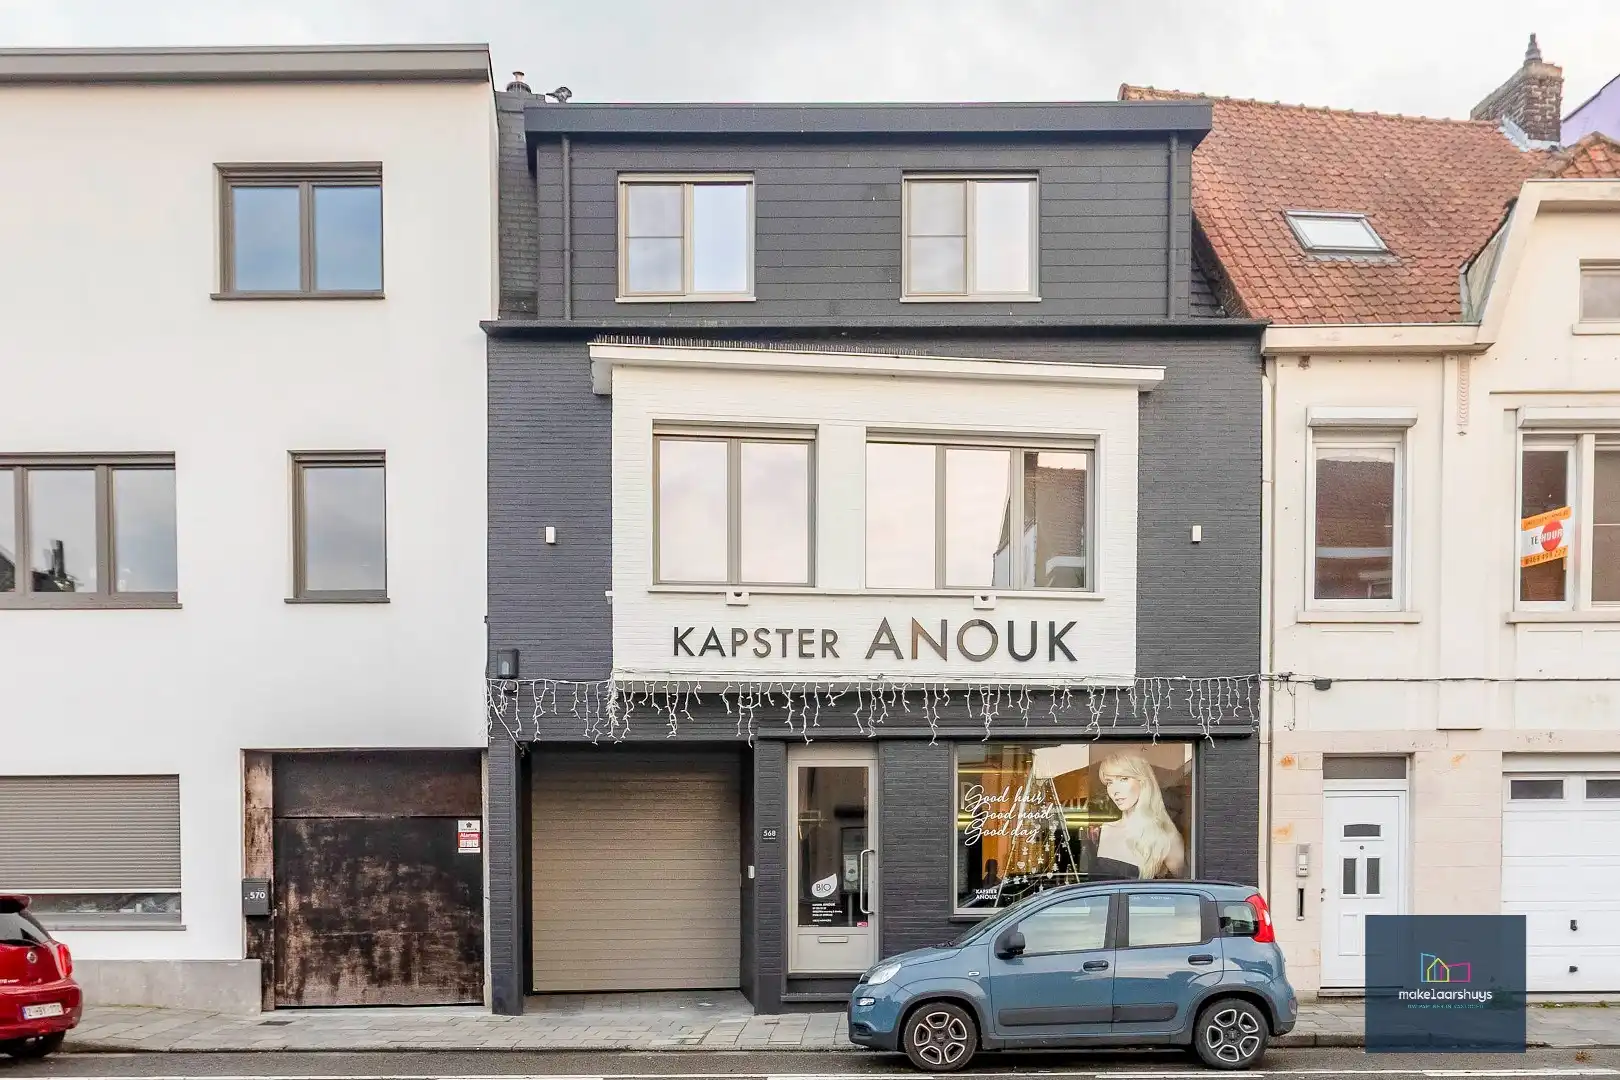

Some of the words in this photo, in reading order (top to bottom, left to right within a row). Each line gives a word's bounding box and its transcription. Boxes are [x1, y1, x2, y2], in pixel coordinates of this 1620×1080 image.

[1530, 535, 1539, 545] TE
[672, 625, 840, 659] KAPSTER
[864, 616, 1078, 662] ANOUK
[965, 785, 1010, 812] Good
[972, 801, 1016, 829] Good
[763, 829, 776, 837] 568
[964, 818, 1010, 846] Good
[1010, 819, 1040, 843] day
[249, 891, 266, 899] 570
[815, 883, 831, 892] BIO
